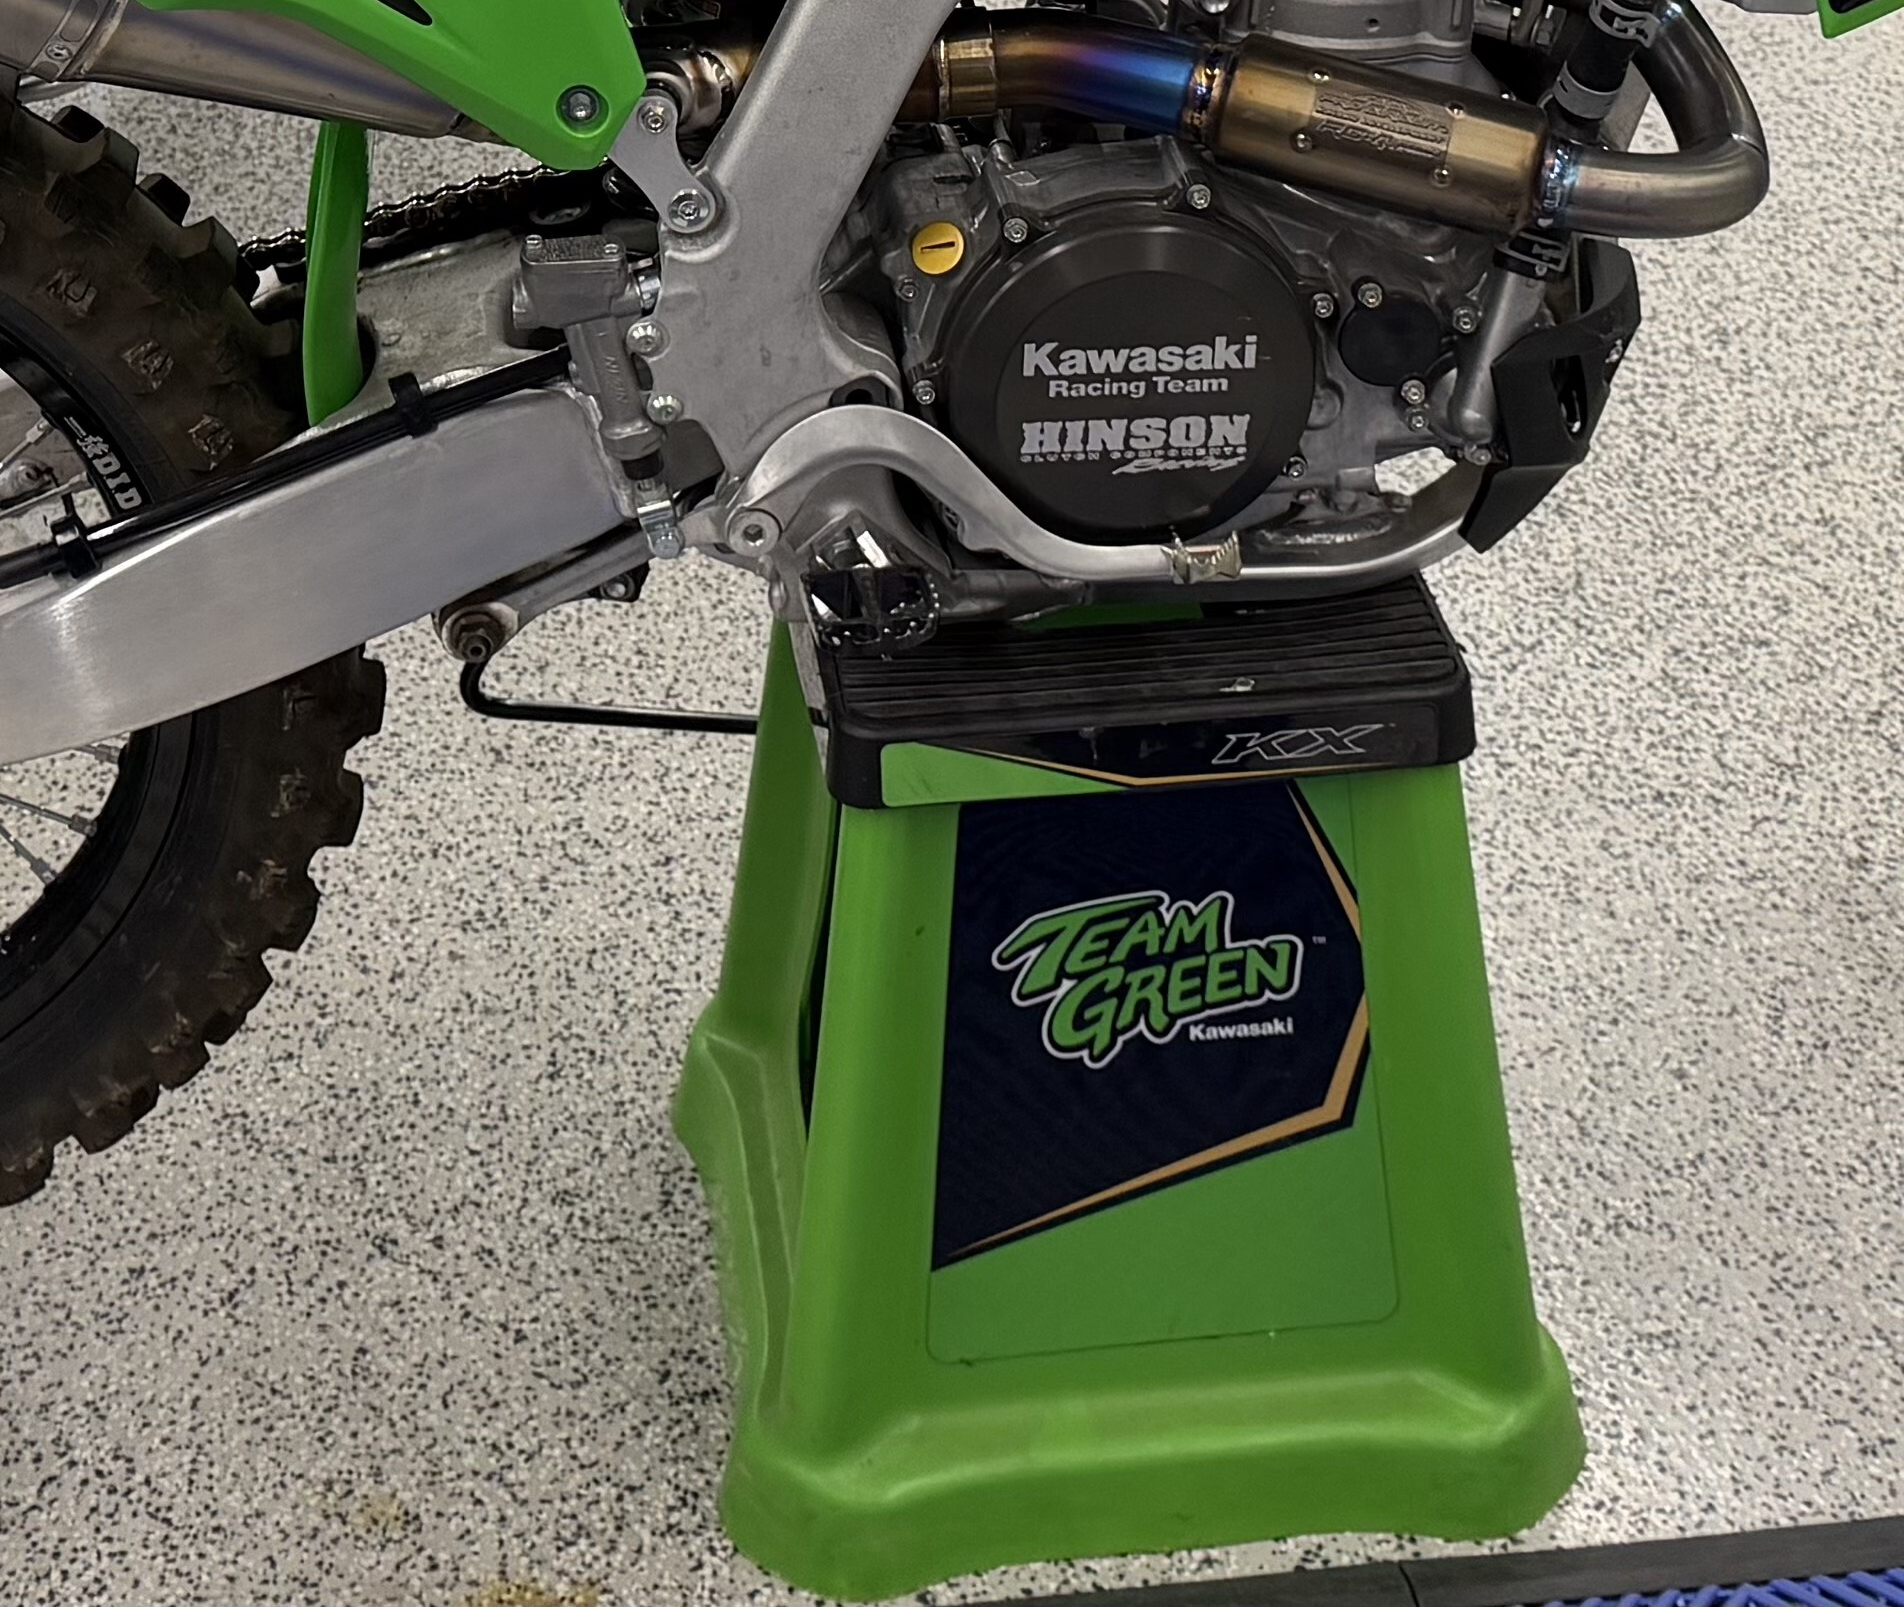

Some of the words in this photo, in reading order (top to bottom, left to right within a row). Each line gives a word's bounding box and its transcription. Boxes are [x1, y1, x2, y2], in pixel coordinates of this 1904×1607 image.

[1022, 335, 1257, 377] Kawasaki
[1048, 378, 1146, 398] Racing
[1152, 376, 1229, 393] Team
[1020, 414, 1250, 454] HINSON
[1211, 724, 1384, 765] KX
[1000, 895, 1223, 996] TEAM
[1051, 941, 1292, 1057] GREEN
[1189, 1016, 1294, 1042] Kawasaki
